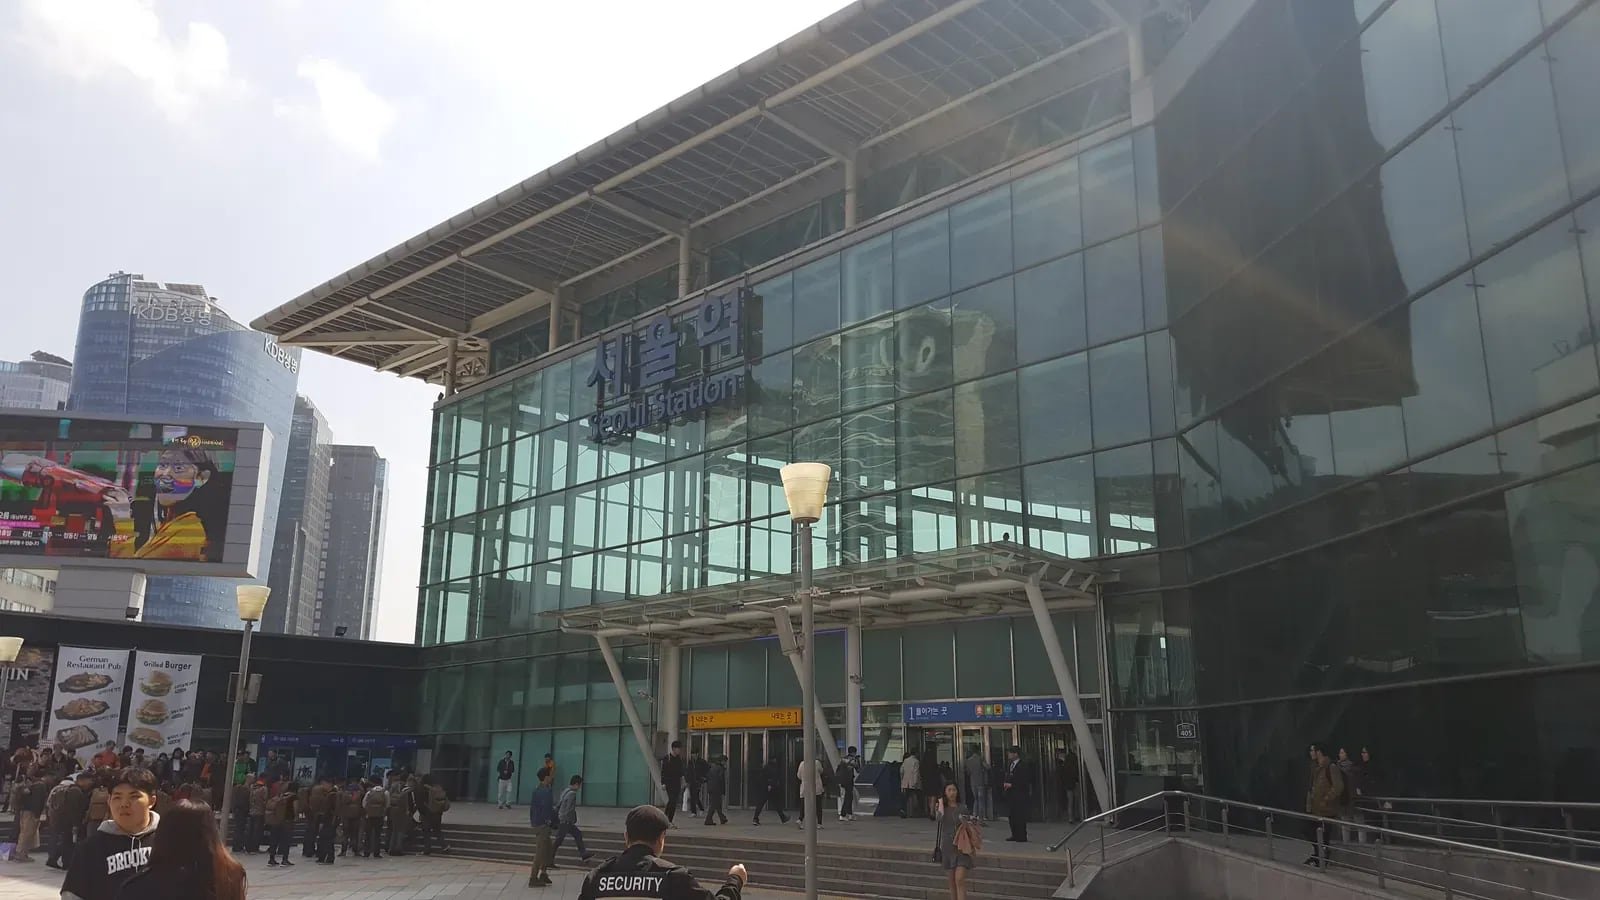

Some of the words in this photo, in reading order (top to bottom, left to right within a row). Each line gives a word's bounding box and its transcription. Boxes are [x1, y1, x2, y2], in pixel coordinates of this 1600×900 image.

[136, 306, 212, 326] KDB생명
[587, 287, 741, 397] 서울역
[264, 337, 298, 374] KDB생명
[588, 394, 649, 440] Seoul
[651, 374, 738, 420] Station
[66, 661, 106, 670] Restaurant
[107, 662, 122, 670] Pub
[79, 655, 109, 663] German
[164, 660, 192, 672] Burger
[916, 707, 939, 716] 들어가는
[940, 706, 948, 716] 곳
[1016, 703, 1043, 713] 들어가는
[1045, 703, 1053, 713] 곳
[1056, 702, 1064, 717] 1
[598, 876, 663, 892] SECURITY
